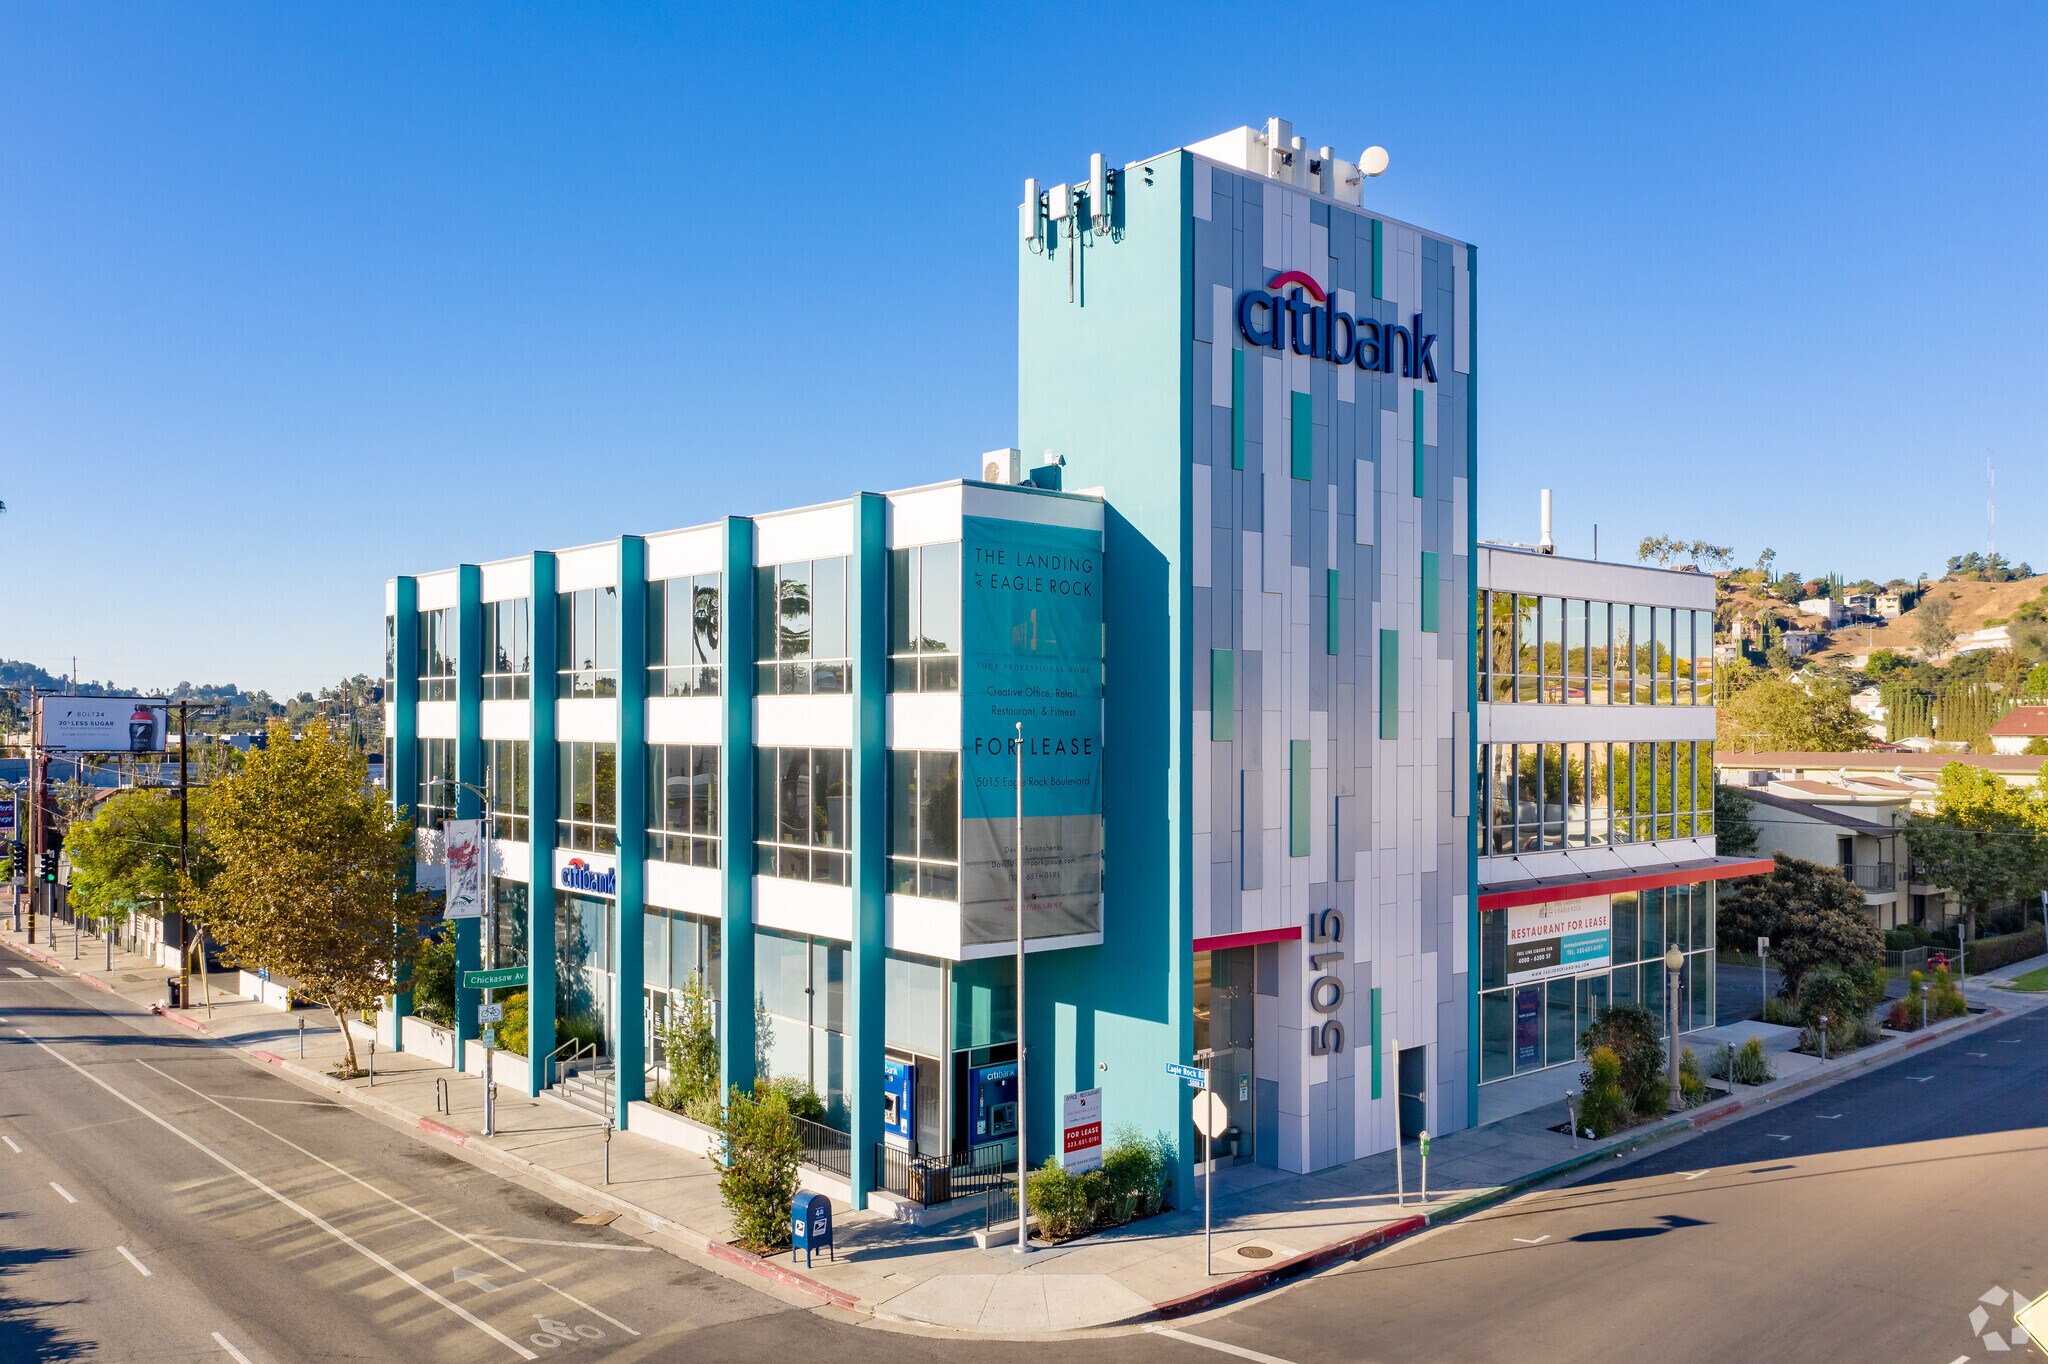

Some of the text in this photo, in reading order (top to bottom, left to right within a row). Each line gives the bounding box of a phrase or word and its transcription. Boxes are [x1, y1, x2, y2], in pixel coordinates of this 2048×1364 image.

[1238, 285, 1438, 383] citibank
[975, 547, 1093, 573] THE LANDING
[975, 572, 983, 587] AT
[991, 574, 1092, 597] EAGLE ROCK
[976, 662, 1091, 674] YOUR PROFESSIONAL HOME
[987, 685, 1080, 700] Creative Office, Retail,
[991, 704, 1077, 718] Restaurant, & Fitness
[975, 737, 1092, 755] FOR LEASE
[976, 774, 1090, 790] 5015 Eage Rock Boulevard
[561, 861, 616, 895] citibank
[1026, 871, 1061, 881] 651-0191
[1511, 915, 1607, 940] RESTAURANT FOR LEASE
[470, 972, 525, 984] Chickasaw Av
[1311, 908, 1345, 1056] 5015
[987, 1068, 1016, 1081] citibank
[1167, 1063, 1182, 1075] Eagle
[1183, 1068, 1197, 1078] Rock
[1065, 1093, 1078, 1101] OFFICE
[1067, 1126, 1099, 1140] FOR LEASE
